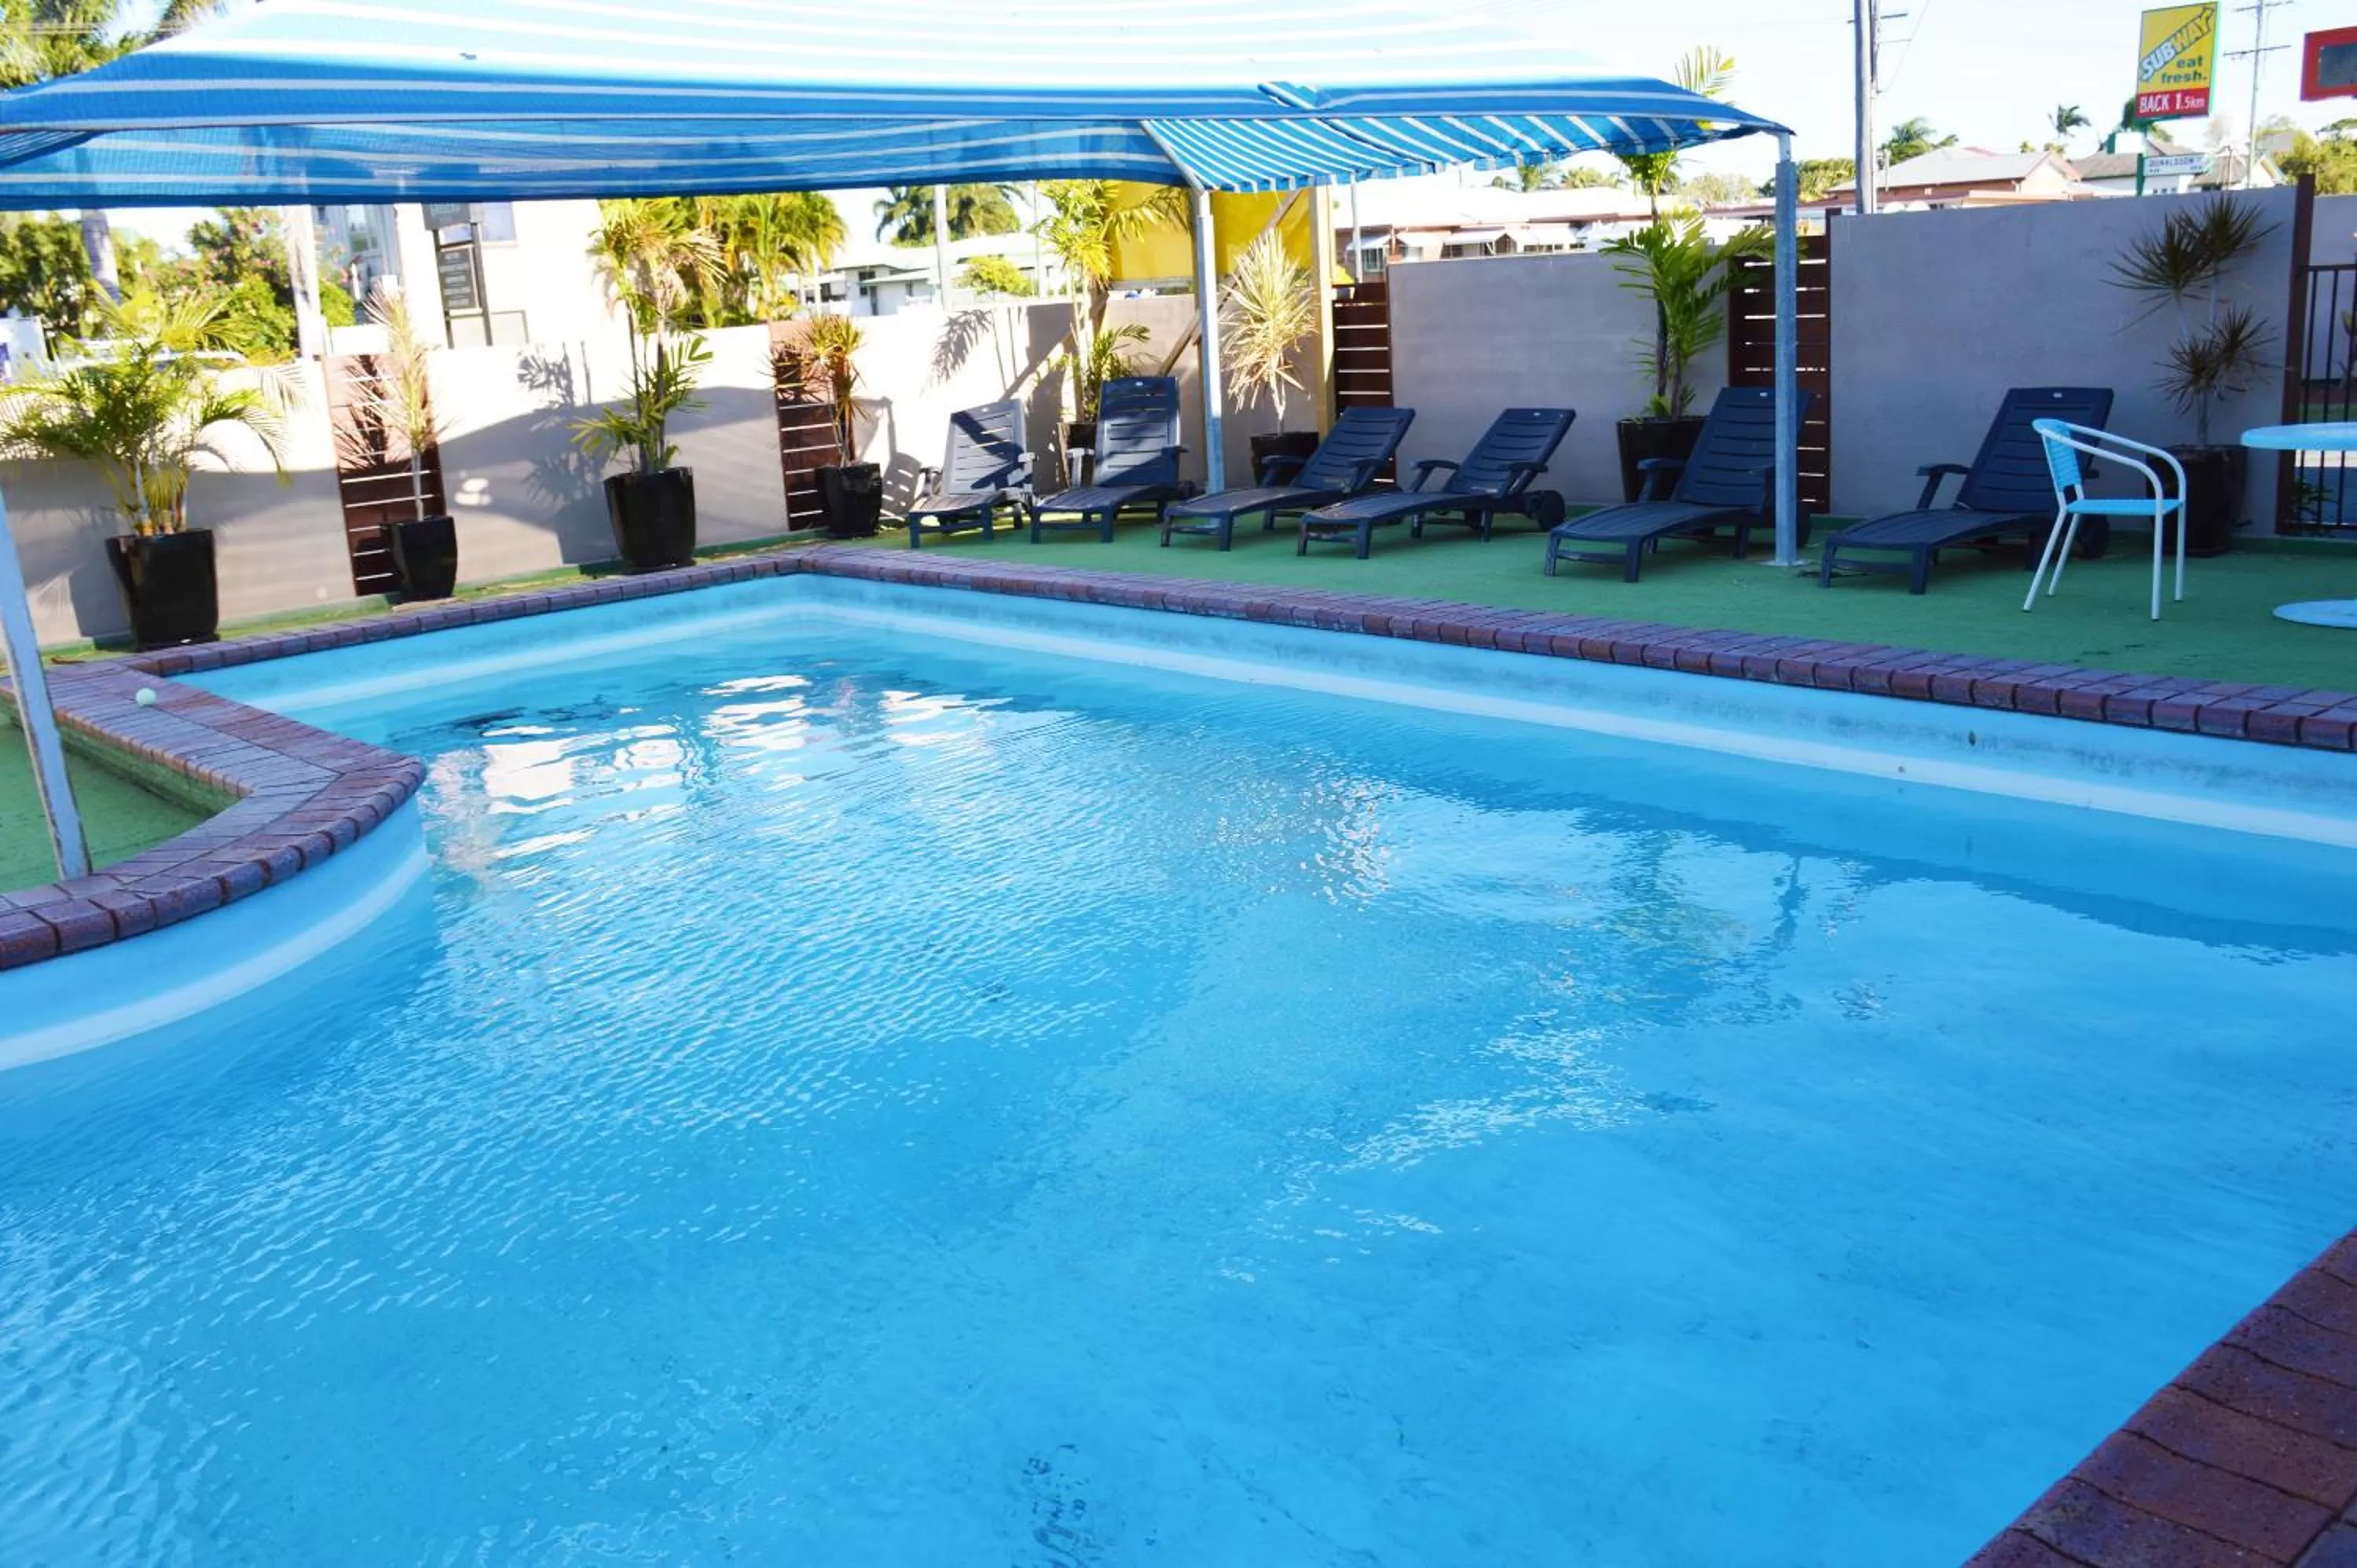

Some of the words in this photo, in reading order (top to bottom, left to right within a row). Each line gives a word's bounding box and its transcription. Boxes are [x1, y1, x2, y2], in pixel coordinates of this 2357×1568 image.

[2139, 6, 2214, 82] SUBWAY
[2176, 56, 2204, 68] eat
[2161, 70, 2208, 84] fresh.
[2139, 94, 2170, 113] BACK
